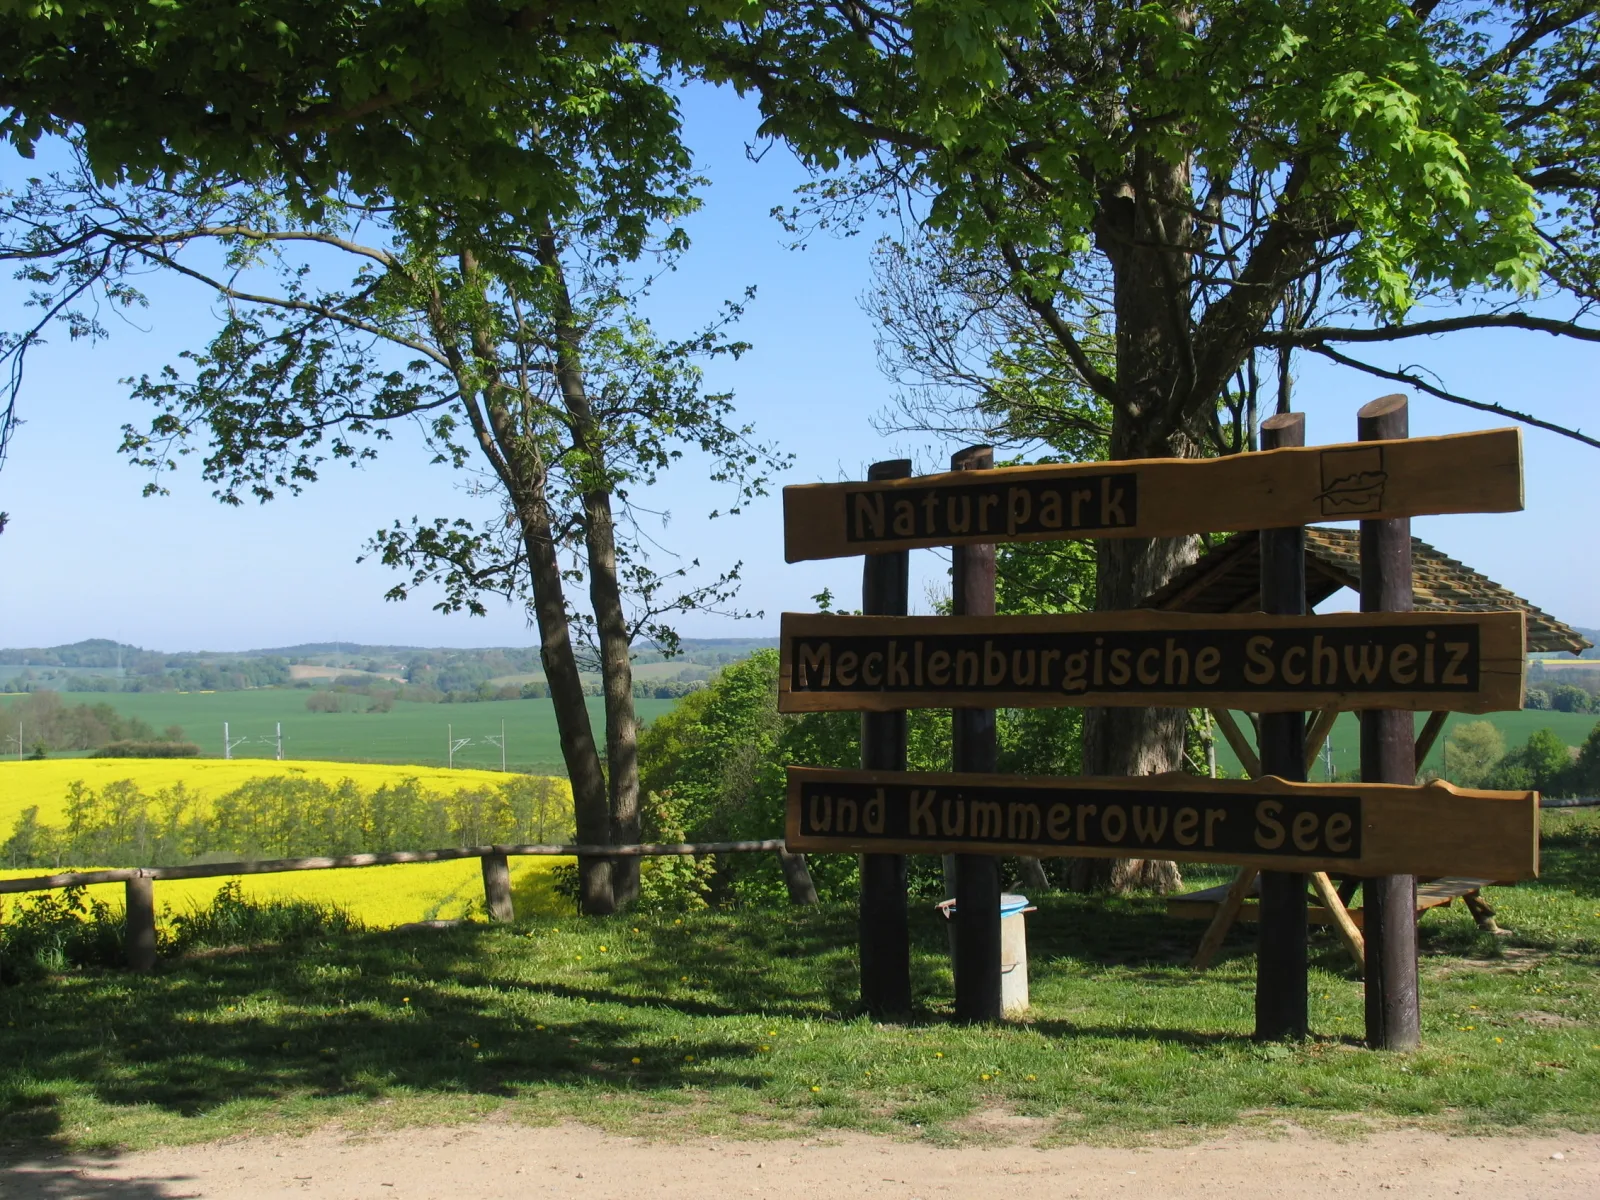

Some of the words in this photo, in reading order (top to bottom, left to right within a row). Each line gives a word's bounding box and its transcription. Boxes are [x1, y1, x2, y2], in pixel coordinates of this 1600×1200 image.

[854, 477, 1126, 537] Naturpark
[799, 637, 1222, 692] Mecklenburgische
[1243, 630, 1469, 685] Schweiz
[809, 788, 886, 834] und
[1254, 800, 1352, 852] See
